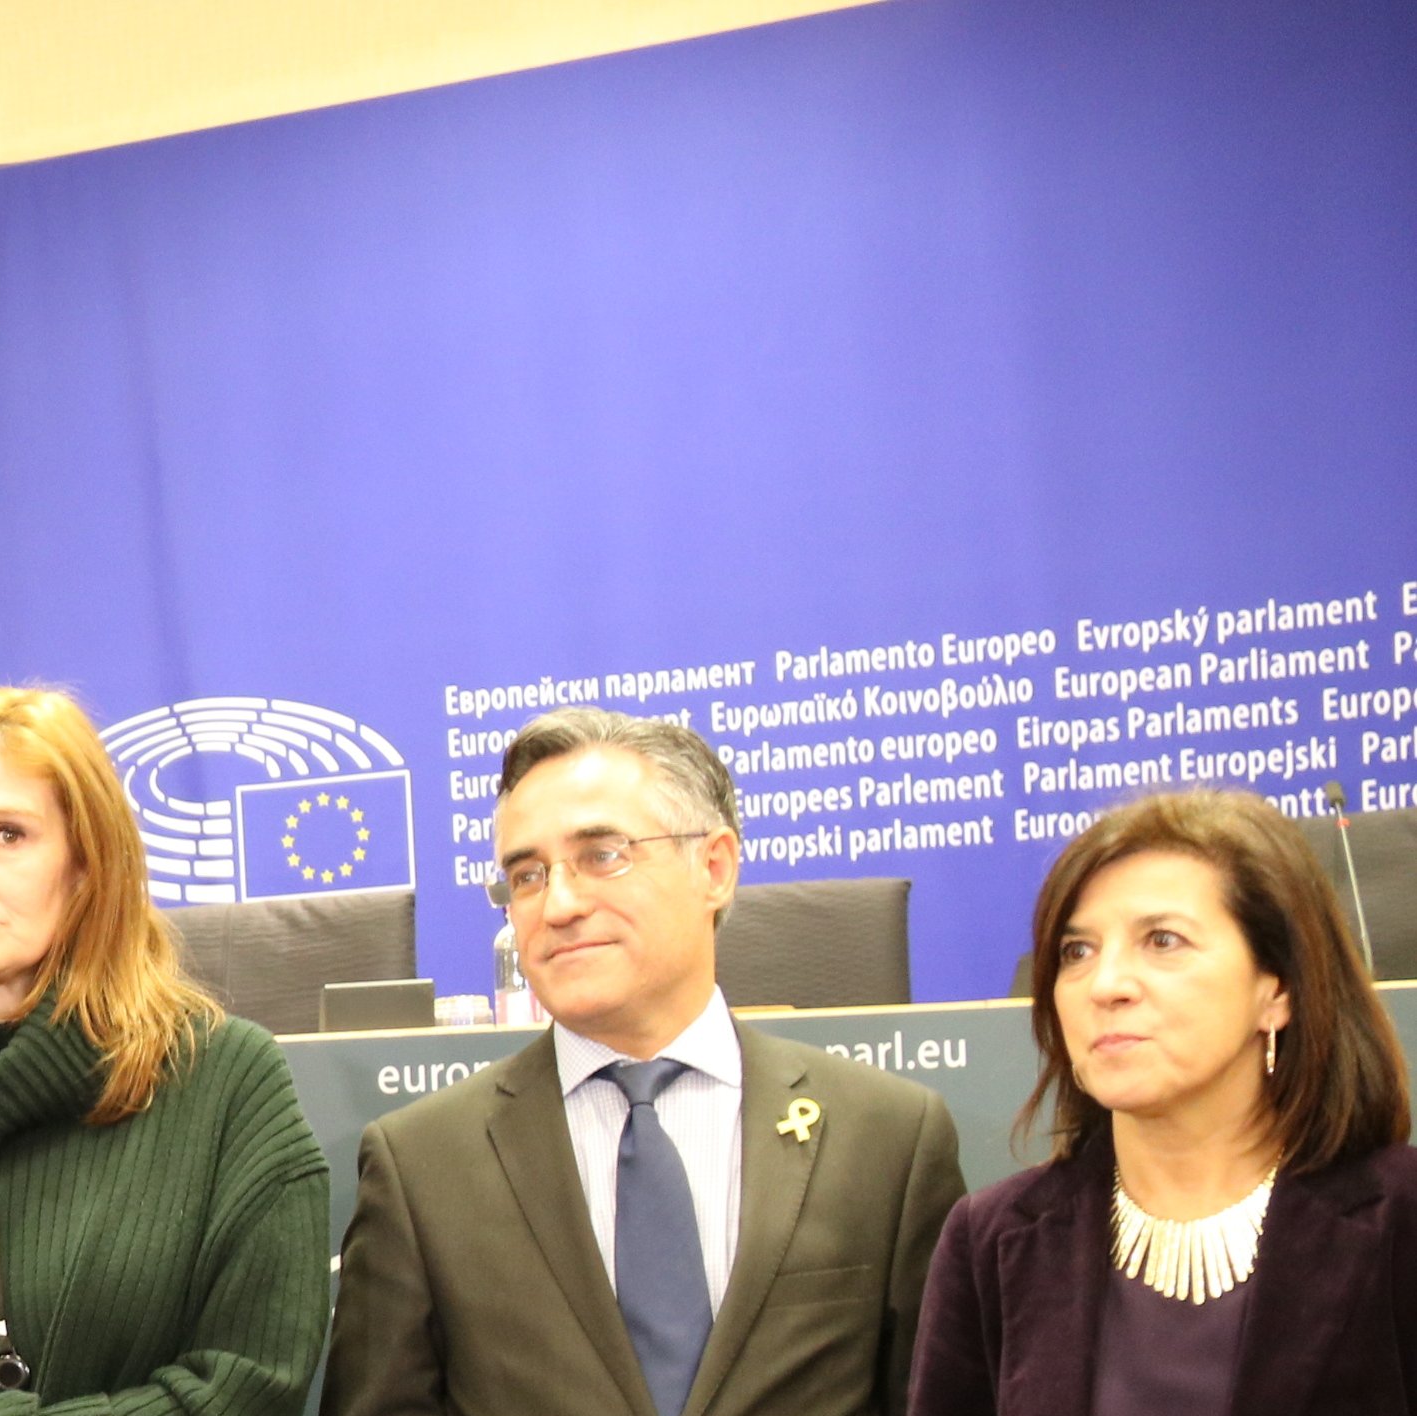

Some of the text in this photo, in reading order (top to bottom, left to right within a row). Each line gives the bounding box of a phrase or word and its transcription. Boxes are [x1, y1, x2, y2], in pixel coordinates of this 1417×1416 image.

[775, 640, 935, 682] Parlamento
[941, 629, 1056, 666] Europeo
[1077, 606, 1209, 653] Evropský
[1217, 590, 1377, 644] parlament
[445, 676, 599, 719] Европейски
[605, 660, 755, 702] парламент
[1055, 662, 1192, 702] European
[1200, 640, 1369, 685] Parliament
[711, 688, 858, 737] Ευρωπαϊκό
[864, 674, 1033, 718] Κοινοβούλιο
[717, 736, 875, 775] Parlamento
[881, 727, 997, 763] europeo
[1017, 716, 1120, 752] Eiropas
[1127, 696, 1299, 740] Parlaments
[858, 768, 1004, 808] Parlement
[1023, 753, 1172, 794] Parlament
[1180, 736, 1337, 782] Europejski
[739, 825, 842, 867] vropski
[849, 815, 994, 862] parlament
